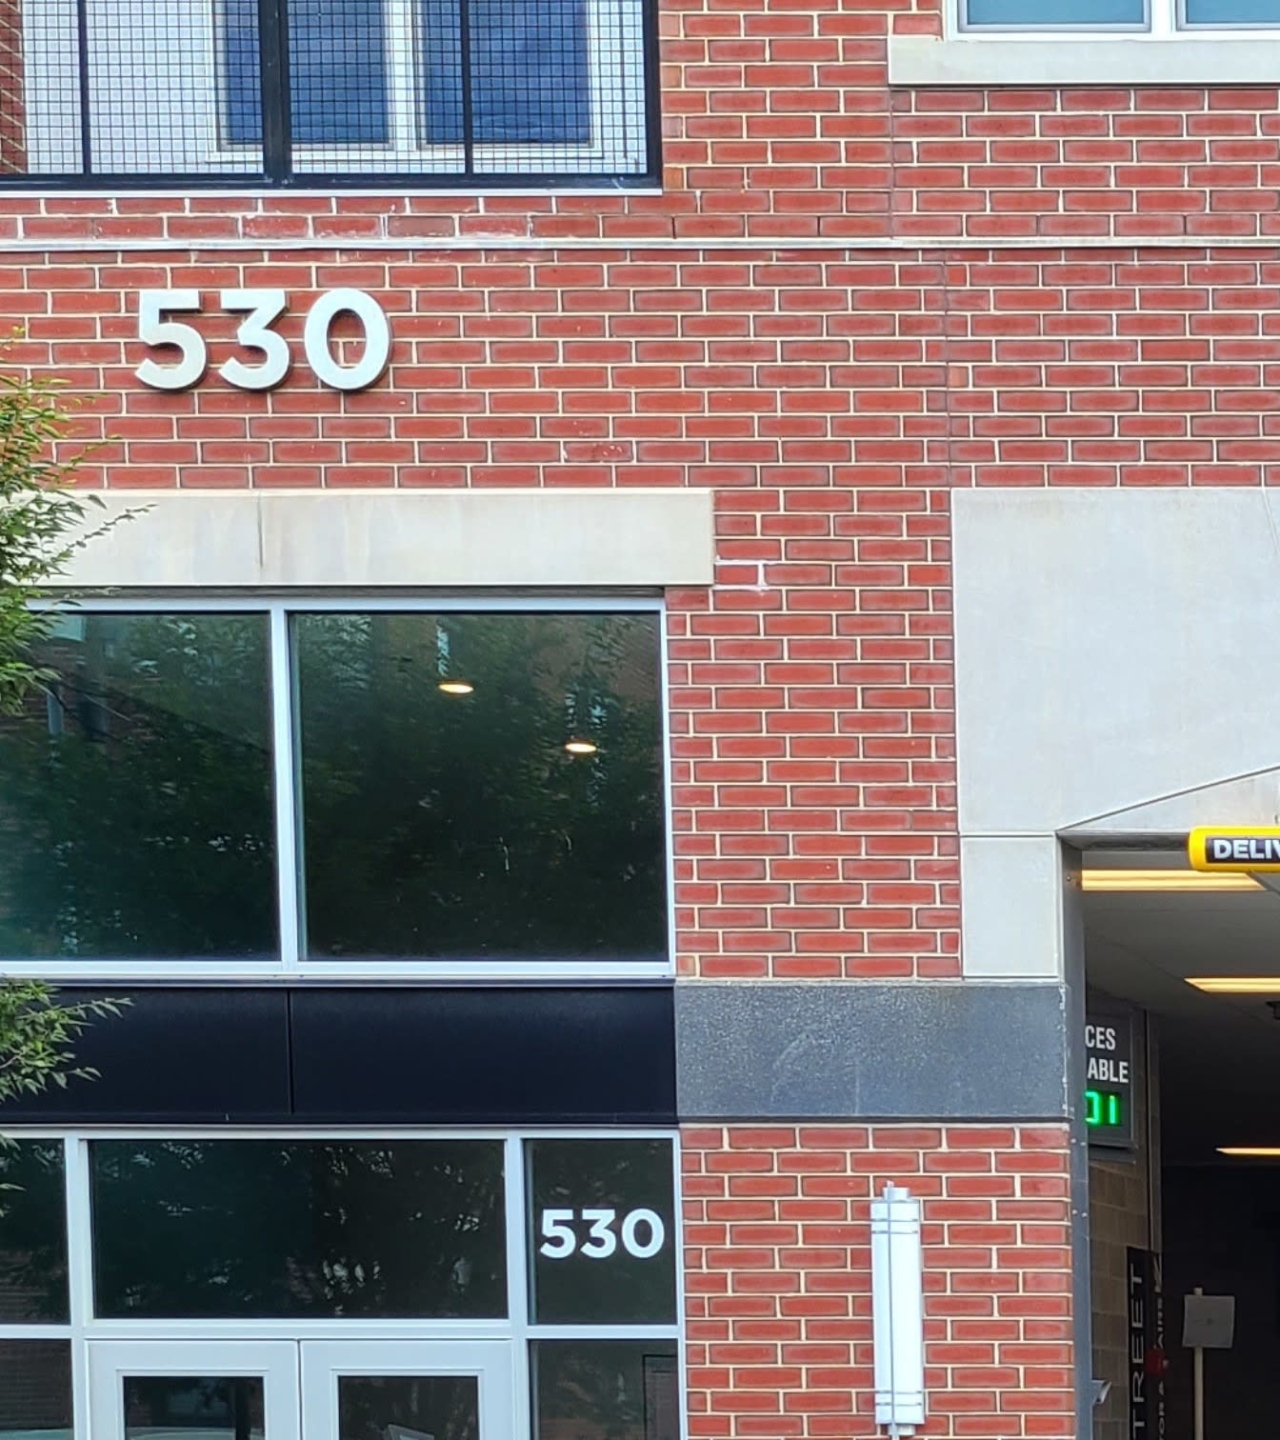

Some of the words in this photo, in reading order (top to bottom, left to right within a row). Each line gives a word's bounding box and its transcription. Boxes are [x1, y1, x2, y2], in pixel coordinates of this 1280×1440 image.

[134, 287, 391, 391] 530
[1084, 1024, 1117, 1050] CES
[539, 1208, 666, 1260] 530
